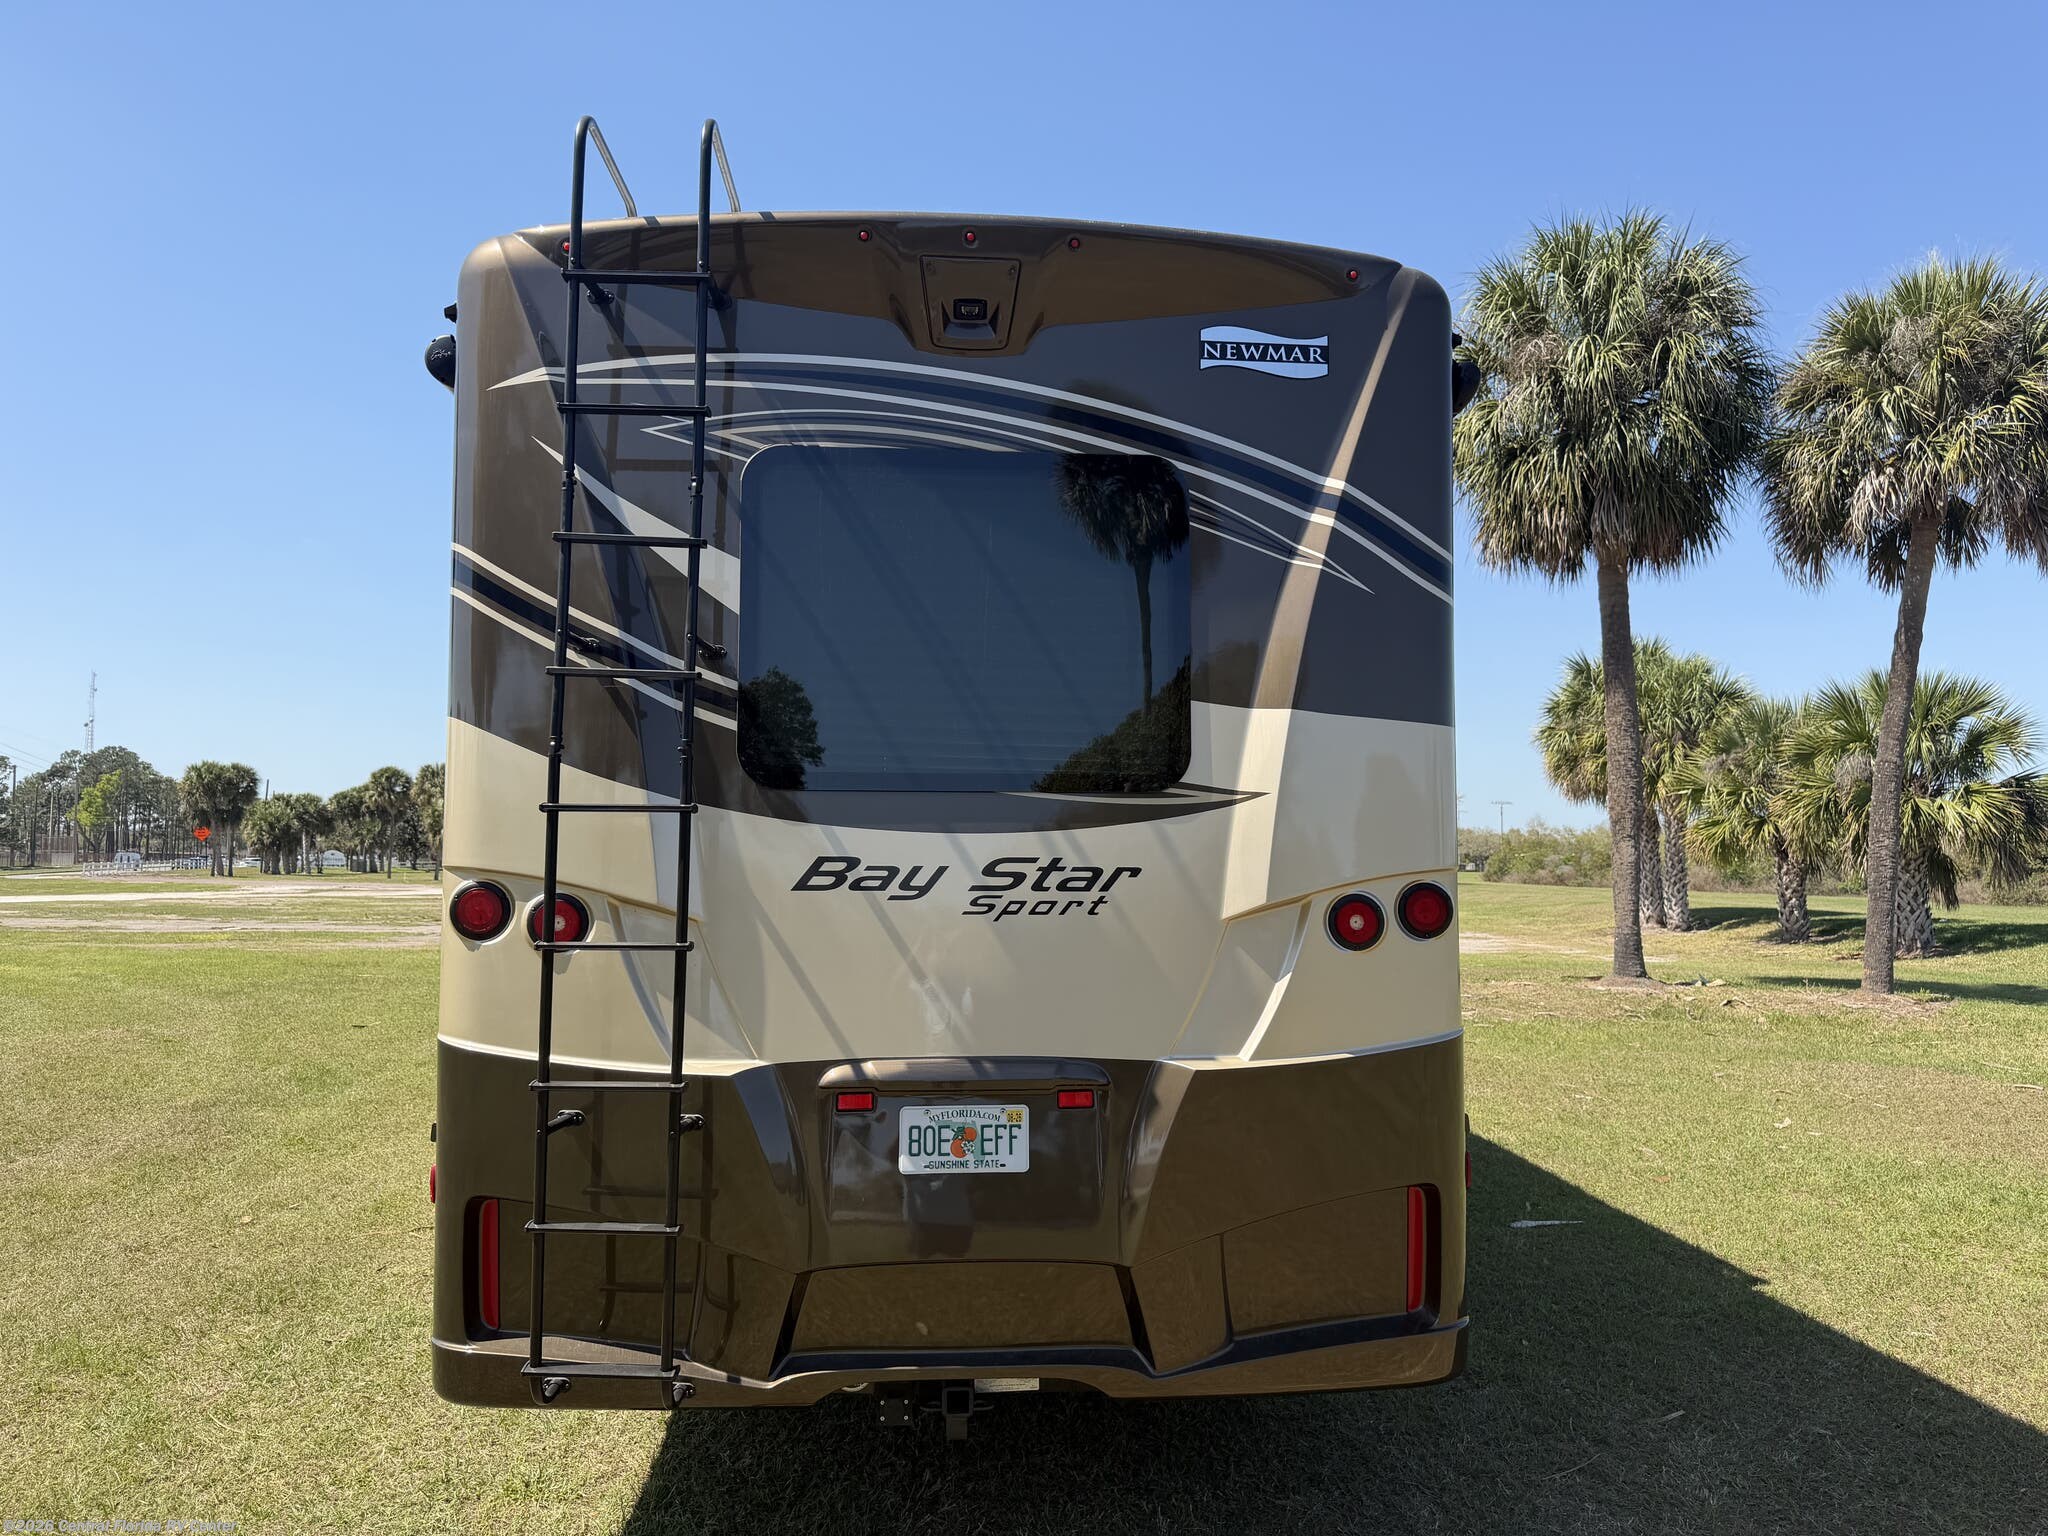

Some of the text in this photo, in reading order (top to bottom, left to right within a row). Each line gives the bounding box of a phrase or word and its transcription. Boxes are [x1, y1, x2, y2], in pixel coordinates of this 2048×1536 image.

[1202, 342, 1327, 363] NEWMAR
[790, 855, 1143, 901] Bay Star
[961, 894, 1112, 922] Sport
[980, 1124, 1022, 1156] EFF
[928, 1159, 1000, 1170] SUNSHINE STATE
